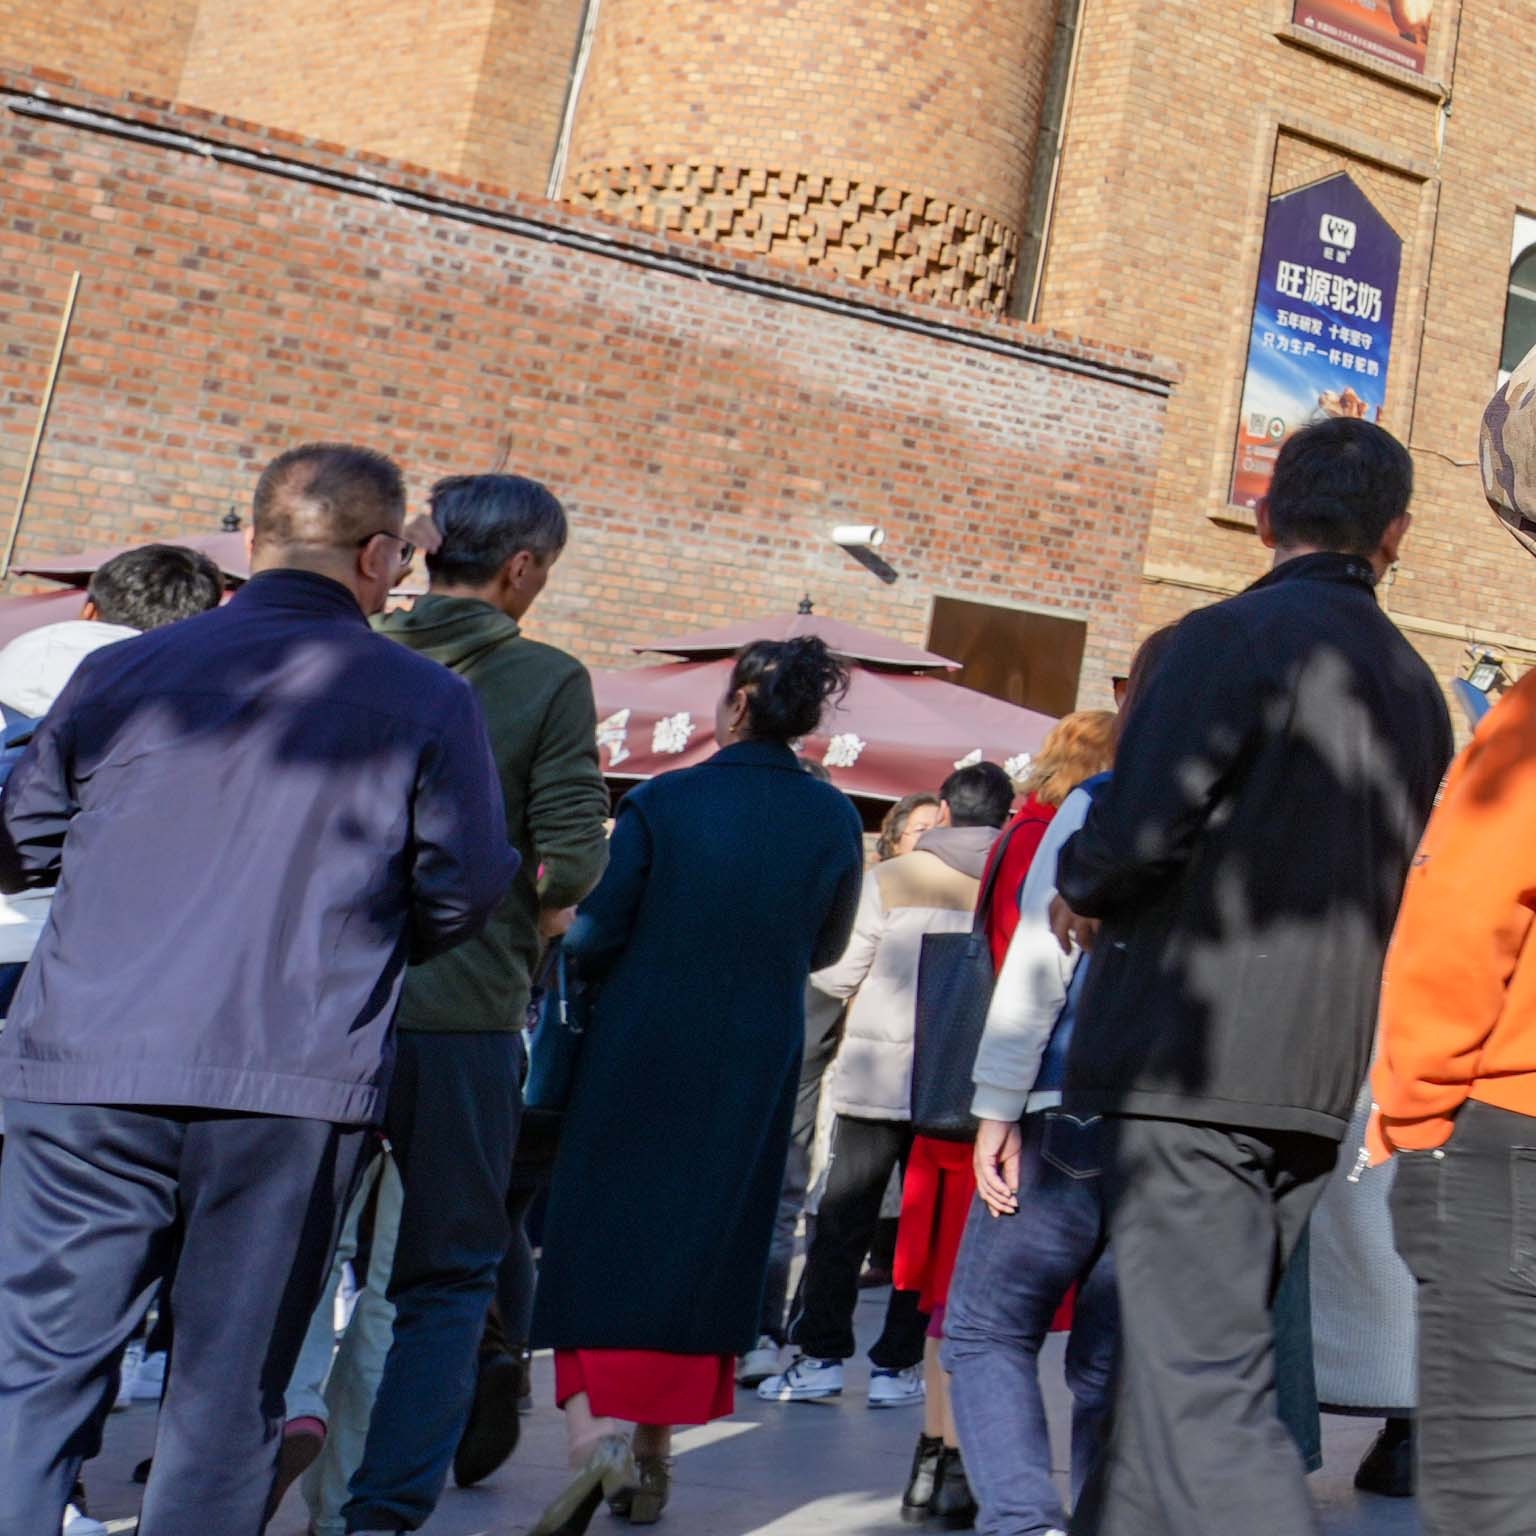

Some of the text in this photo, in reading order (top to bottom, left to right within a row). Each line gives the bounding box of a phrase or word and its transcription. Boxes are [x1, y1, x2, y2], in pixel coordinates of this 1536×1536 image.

[1275, 260, 1383, 323] 旺源驼奶
[1276, 309, 1373, 350] 五年研发 十年坚守
[1263, 332, 1379, 376] 只为生产一杯好驼奶
